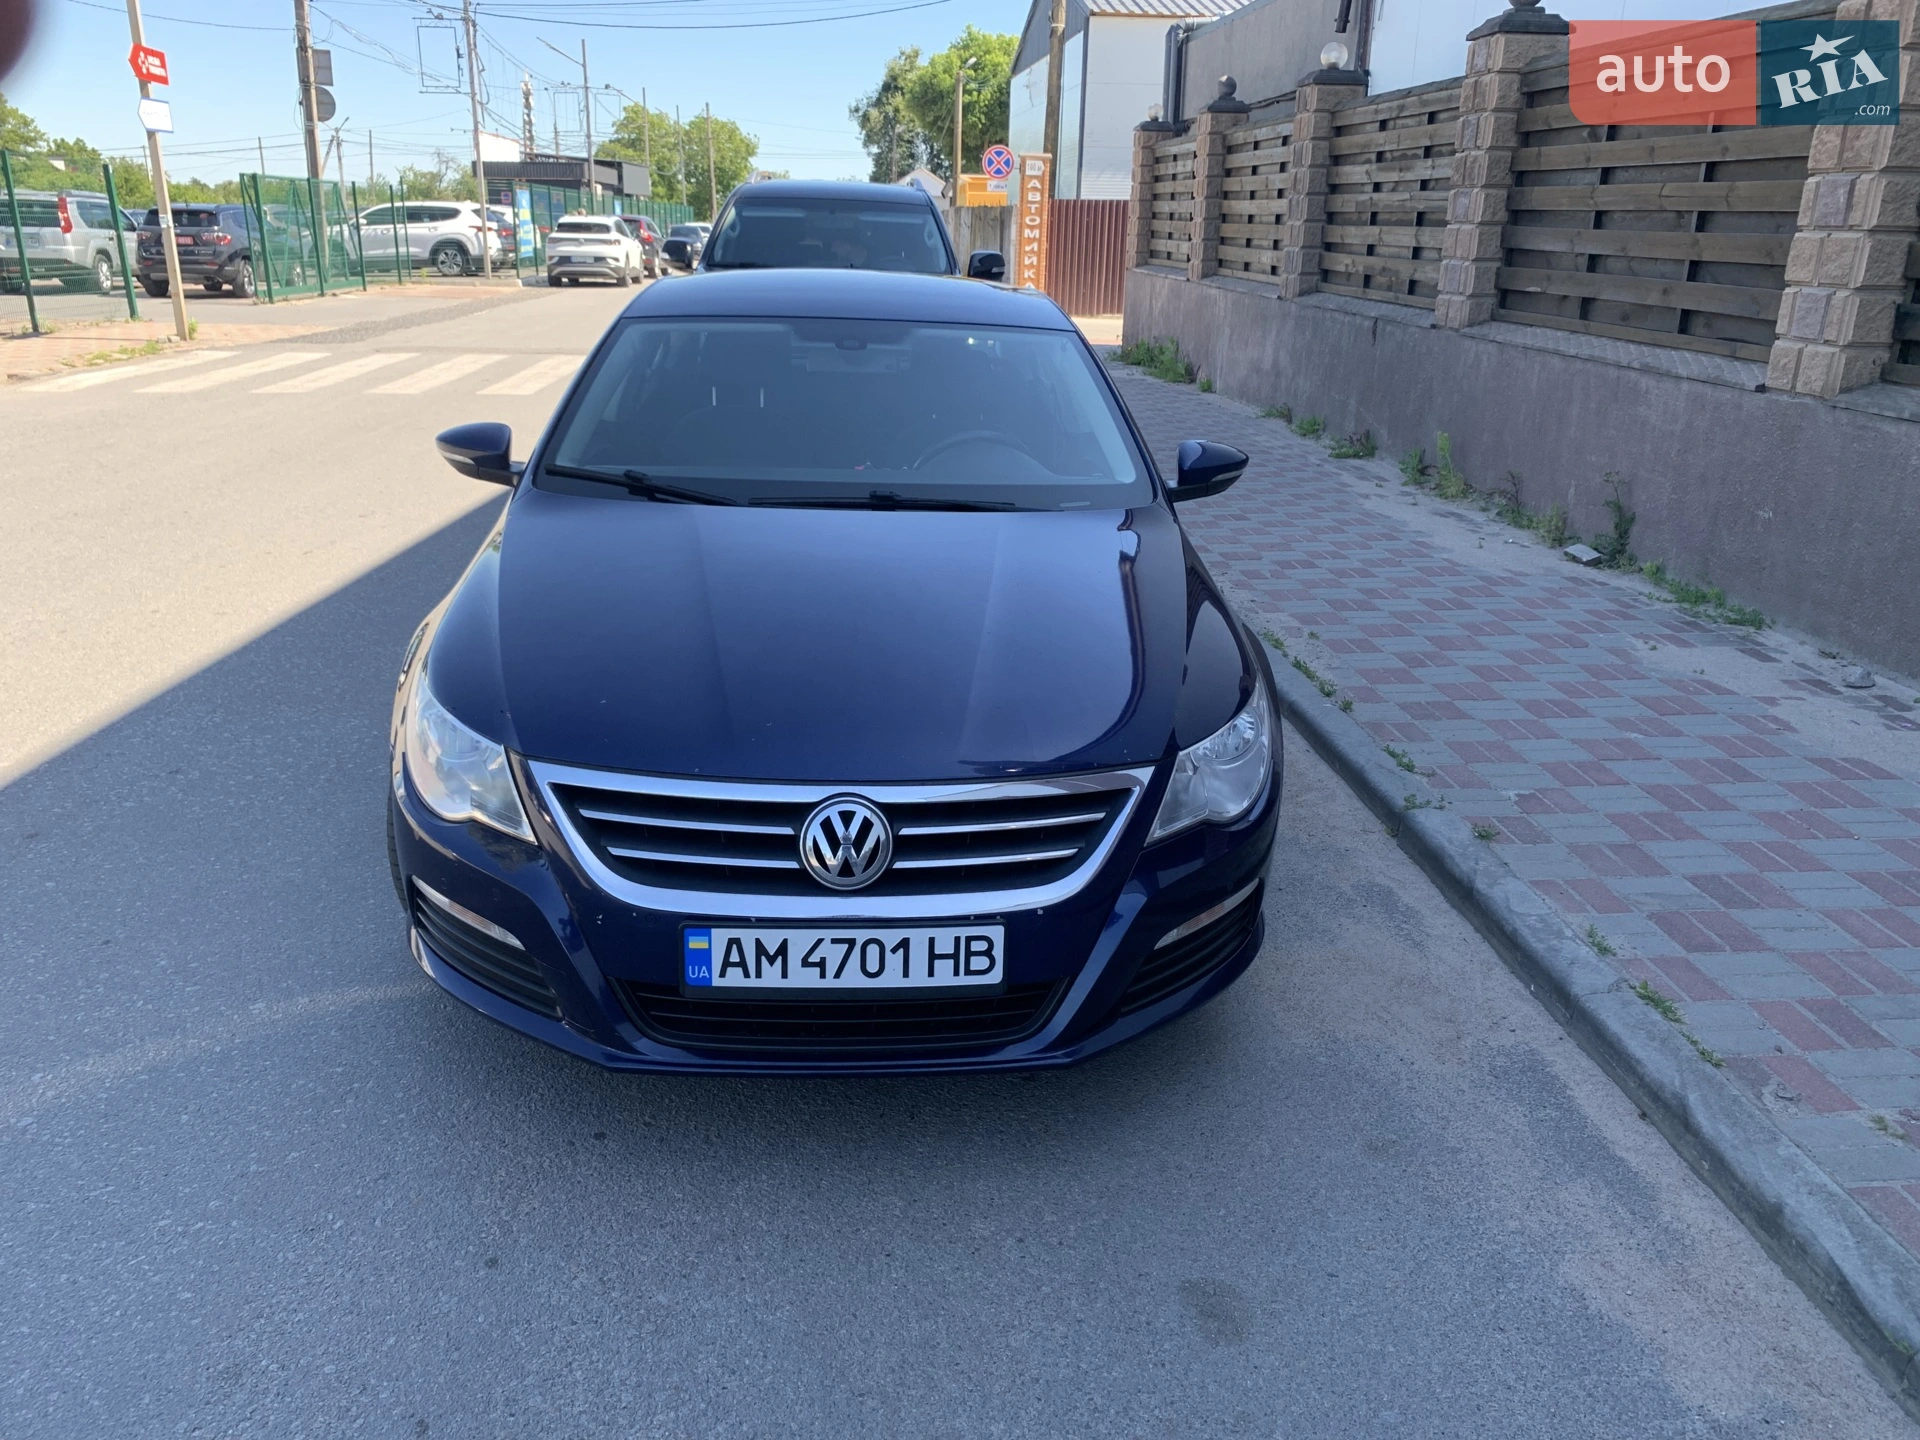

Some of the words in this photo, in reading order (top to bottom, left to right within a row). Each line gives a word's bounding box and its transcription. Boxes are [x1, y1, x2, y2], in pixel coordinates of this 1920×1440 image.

[1023, 179, 1042, 289] АВТОМИЙКА
[688, 965, 710, 979] UA
[718, 937, 789, 979] AM
[800, 936, 910, 979] 4701
[927, 934, 997, 978] HB
